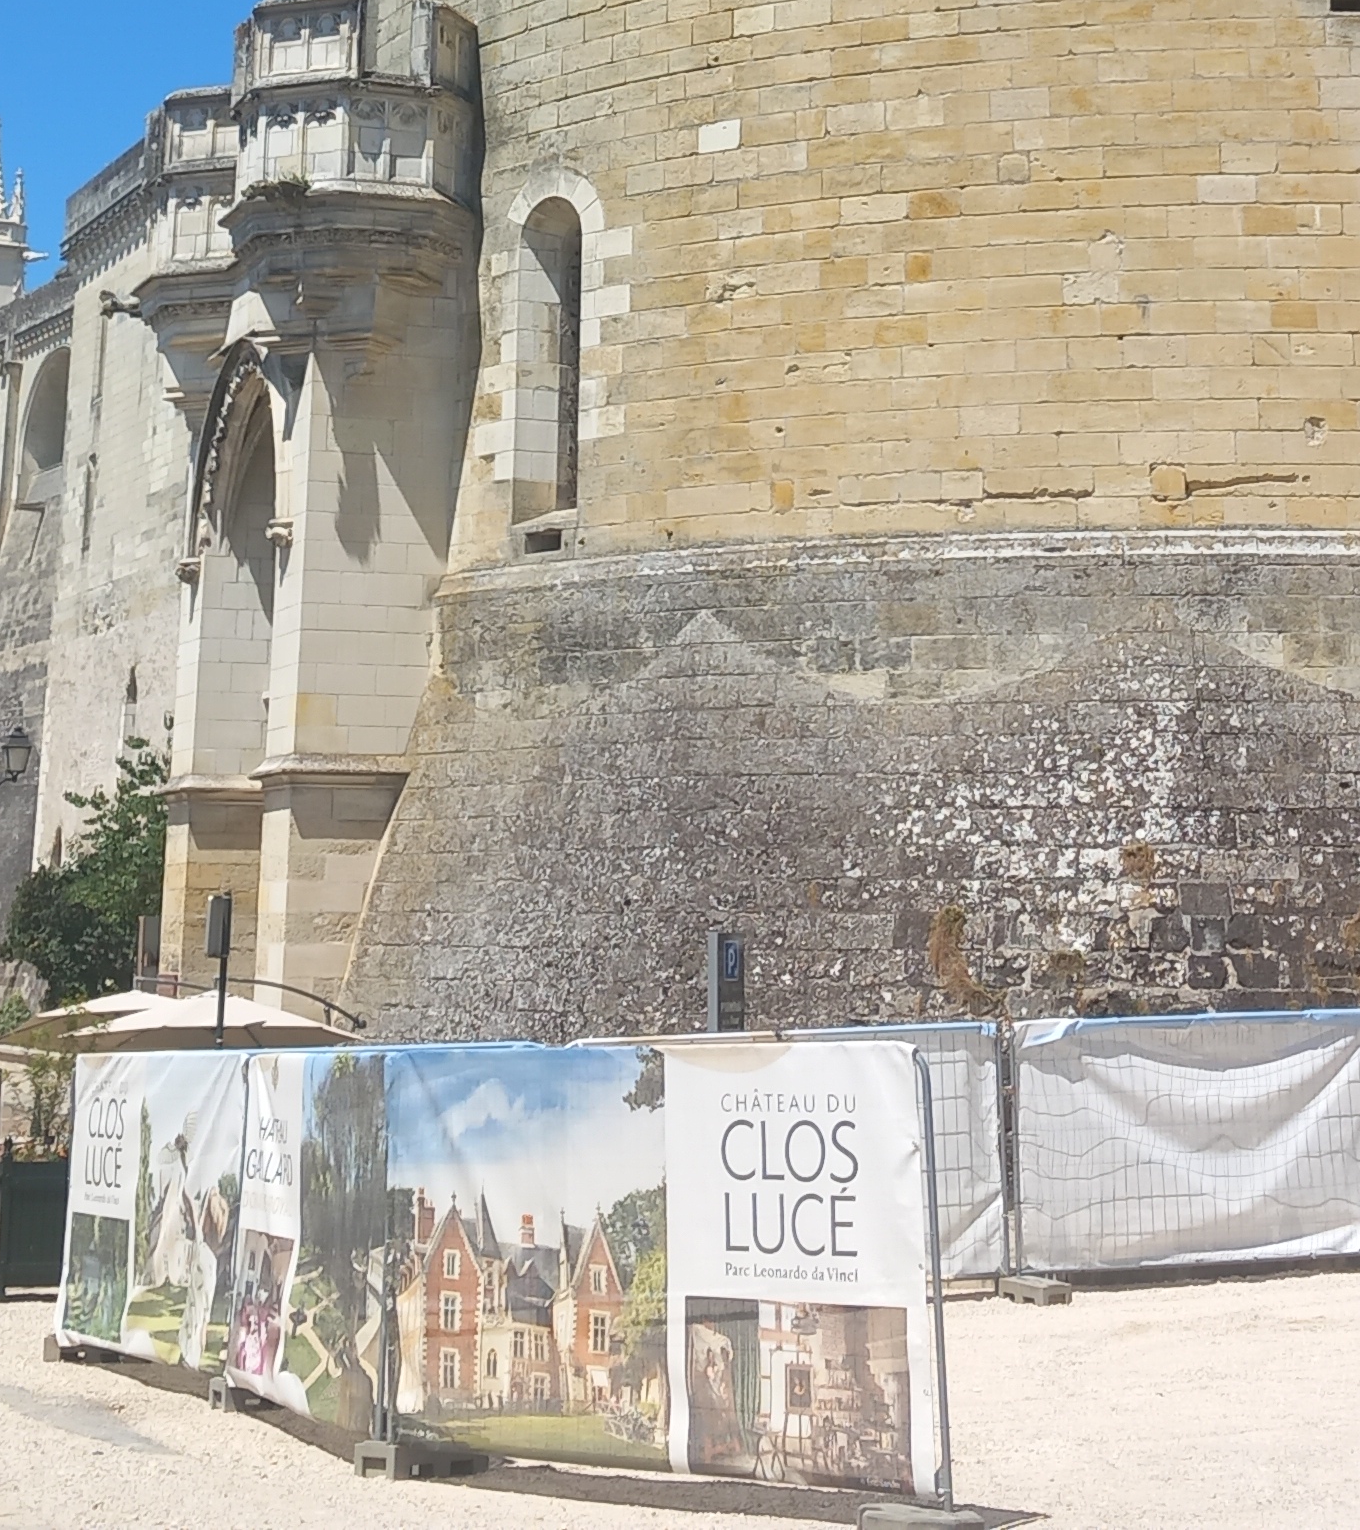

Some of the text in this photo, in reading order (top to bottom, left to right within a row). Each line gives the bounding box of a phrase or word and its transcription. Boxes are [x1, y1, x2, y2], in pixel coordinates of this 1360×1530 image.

[727, 947, 736, 975] P
[88, 1096, 128, 1140] CLOS
[720, 1087, 857, 1114] CHÂTEAU DU
[84, 1141, 123, 1189] LUCÉ
[720, 1118, 859, 1184] CLOS
[723, 1186, 859, 1258] LUCÉ
[724, 1261, 859, 1283] Parc Leonardo da Vinci
